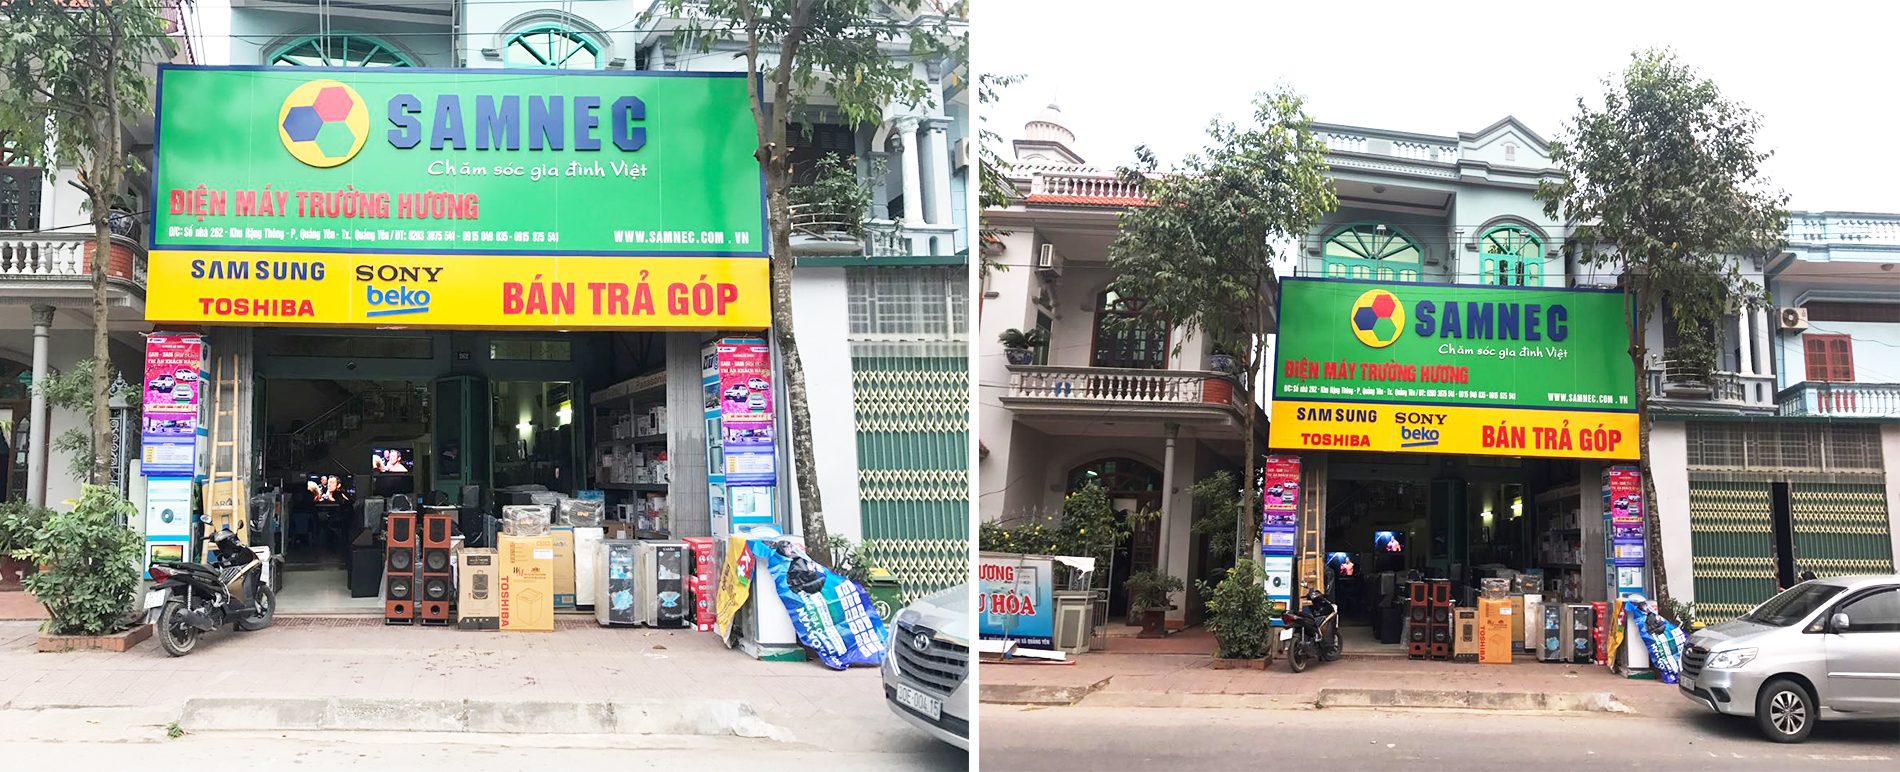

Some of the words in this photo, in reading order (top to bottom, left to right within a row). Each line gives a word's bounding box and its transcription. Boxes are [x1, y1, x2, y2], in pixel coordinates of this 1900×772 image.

[387, 94, 647, 152] SAMNEC
[427, 159, 487, 176] Chăm
[494, 162, 524, 176] sóc
[530, 164, 559, 181] gia
[565, 160, 605, 177] đình
[610, 160, 648, 180] Việt
[169, 184, 226, 221] ĐIỆN
[235, 184, 289, 218] MÁY
[296, 184, 390, 219] TRƯỜNG
[398, 190, 480, 220] HƯƠNG
[210, 227, 223, 238] 262
[229, 227, 243, 238] Khu
[614, 230, 724, 244] WWW.SAMNEC.COM
[356, 265, 444, 282] SONY
[366, 285, 430, 306] beko
[503, 274, 575, 315] BÁN
[588, 270, 655, 316] TRẢ
[667, 274, 738, 316] GÓP
[199, 298, 314, 317] TOSHIBA
[1415, 300, 1568, 342] SAMNEC
[1438, 343, 1474, 356] Chăm
[1477, 346, 1496, 356] sóc
[1499, 347, 1516, 359] gia
[1519, 346, 1543, 357] đình
[1545, 347, 1568, 359] Việt
[1284, 356, 1319, 381] ĐIỆN
[1324, 357, 1357, 380] MÁY
[1360, 359, 1416, 382] TRƯỜNG
[1420, 364, 1469, 384] HƯƠNG
[1395, 412, 1447, 425] SONY
[1301, 433, 1370, 447] TOSHIBA
[1402, 426, 1439, 440] beko
[1482, 424, 1525, 449] BÁN
[1532, 420, 1572, 450] TRẢ
[1580, 424, 1622, 452] GÓP
[501, 576, 509, 627] TOSHIBA
[991, 589, 1036, 615] HÒA
